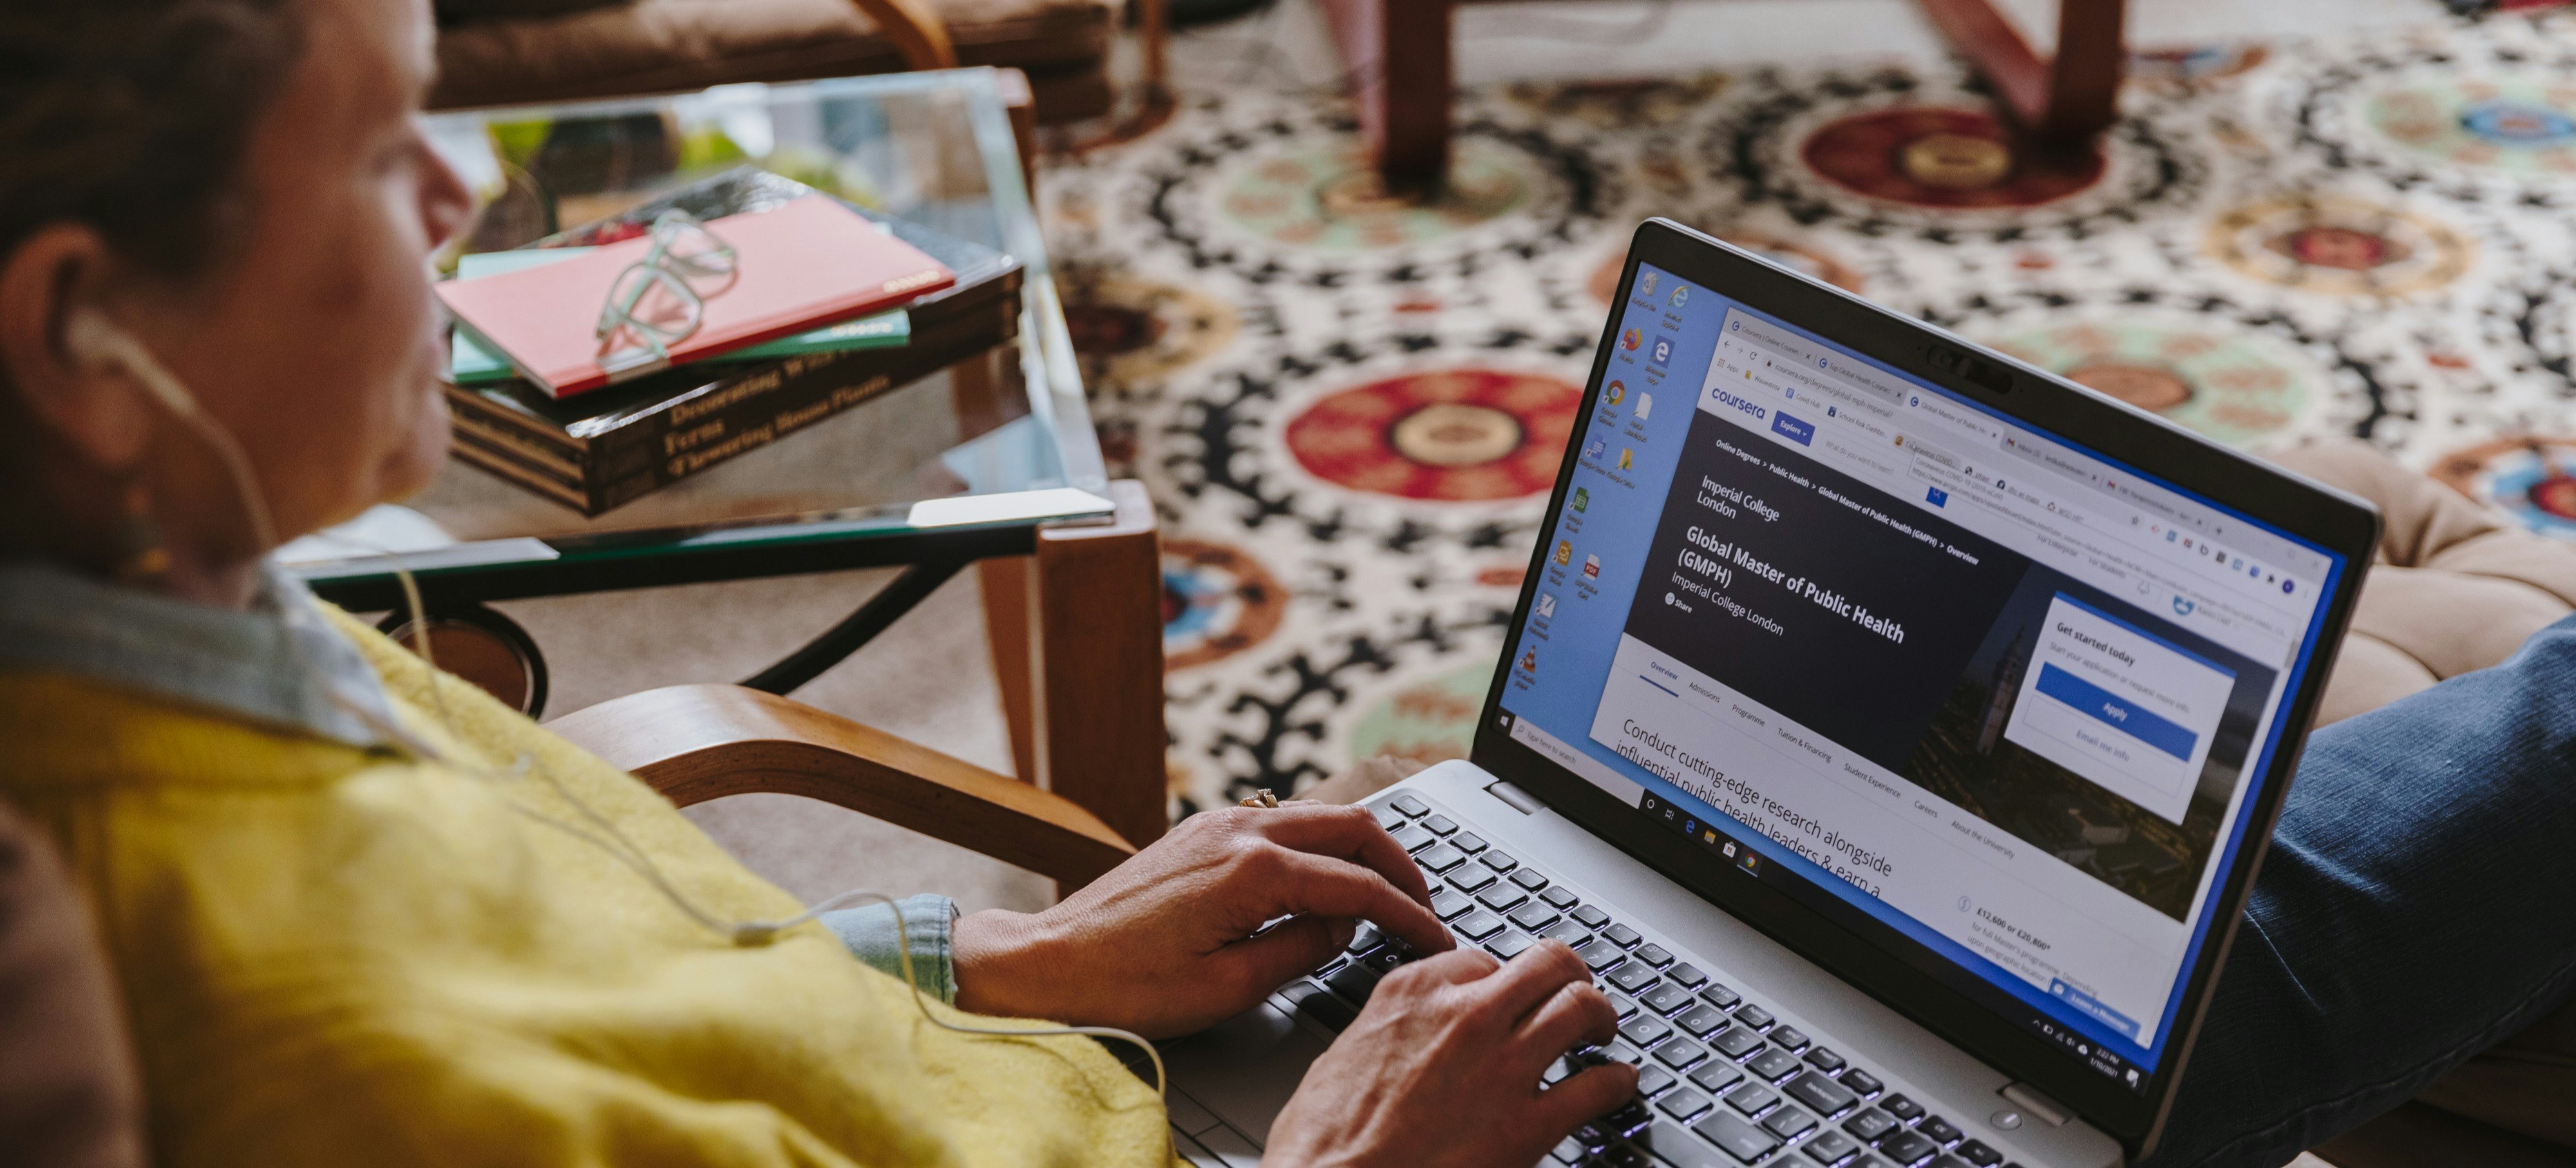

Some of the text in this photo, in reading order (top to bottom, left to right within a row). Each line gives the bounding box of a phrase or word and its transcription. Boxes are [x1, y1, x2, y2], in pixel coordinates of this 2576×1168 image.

[1741, 326, 1799, 355] Coursera Online Courses
[1727, 364, 1738, 374] Apps
[1830, 363, 1890, 394] Top Global Health Courses
[1711, 387, 1766, 420] coursera
[1796, 394, 1820, 408] Covid Hub
[1921, 402, 1937, 414] Global
[1938, 410, 1955, 421] Master
[1963, 419, 1975, 429] Public
[1779, 420, 1801, 436] Explore
[1839, 412, 1864, 428] School Risk
[1826, 441, 1839, 451] What
[1839, 446, 1847, 455] do
[1847, 452, 1857, 461] you
[1858, 455, 1870, 465] want
[1877, 463, 1893, 475] learn?
[1916, 457, 1945, 475] Coronavirus
[1697, 490, 1737, 519] London
[1701, 475, 1780, 525] Imperial College
[1716, 439, 1978, 565] Online Degrees Public Health Global Master of Public Health (GMPH) Overview
[1586, 565, 1596, 574] PDF
[1677, 547, 1732, 589] (GMPH)
[1686, 524, 1906, 644] Global Master of Public Health
[1671, 571, 1785, 636] Imperial College London
[1675, 599, 1692, 613] Share
[2057, 622, 2136, 667] Get started today
[2049, 642, 2065, 655] Start
[2066, 651, 2081, 664] your
[2082, 657, 2119, 681] application
[2128, 680, 2155, 698] request
[2156, 693, 2174, 706] more
[2103, 702, 2128, 723] Apply
[1526, 731, 1538, 743] Type
[1539, 738, 1550, 749] here
[1558, 749, 1576, 763] search
[2076, 729, 2130, 762] Email me info
[1651, 662, 1678, 680] Overview
[1689, 681, 1720, 703] Admissions
[1732, 704, 1765, 727] Programme
[1777, 728, 1797, 743] Tuition
[1804, 742, 1832, 763] Financing
[1844, 763, 1867, 781] Student
[1868, 776, 1901, 799] Experience
[1914, 800, 1938, 818] Careers
[1951, 820, 1970, 835] About
[1971, 830, 1982, 841] the
[1982, 837, 2014, 859] University
[1622, 717, 1893, 881] Conduct cutting-edge research alongside
[1616, 740, 1880, 897] influential public health leaders & earn a
[1472, 919, 1484, 928] R
[1972, 923, 1982, 932] for
[1983, 928, 1993, 939] full
[1976, 908, 2005, 929] £12,600
[1967, 935, 2047, 982] upon geographic location
[1748, 1006, 1767, 1020] home
[1638, 1025, 1651, 1033] O
[1672, 1047, 1685, 1055] P
[2109, 1054, 2119, 1064] PM
